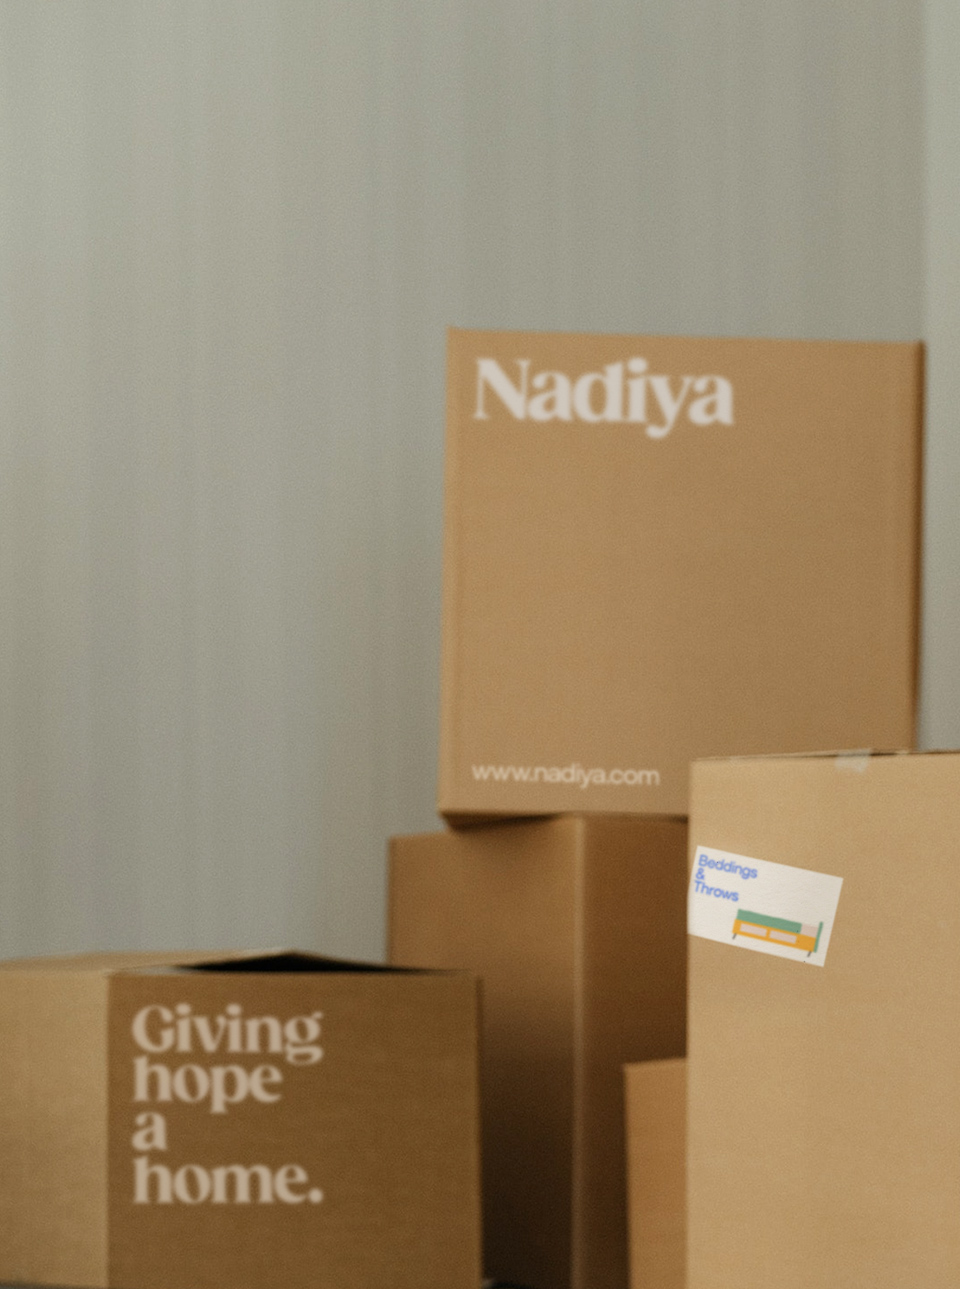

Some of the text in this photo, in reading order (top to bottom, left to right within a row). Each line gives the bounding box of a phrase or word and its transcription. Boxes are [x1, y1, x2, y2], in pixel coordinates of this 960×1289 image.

[474, 357, 734, 438] Nadiya
[472, 763, 660, 789] www.nadiya.com
[695, 867, 705, 881] &
[698, 854, 758, 880] Beddings
[694, 880, 739, 902] Throws
[132, 1003, 324, 1065] Giving
[133, 1055, 283, 1114] hope
[132, 1111, 168, 1151] a
[133, 1156, 324, 1205] home.
